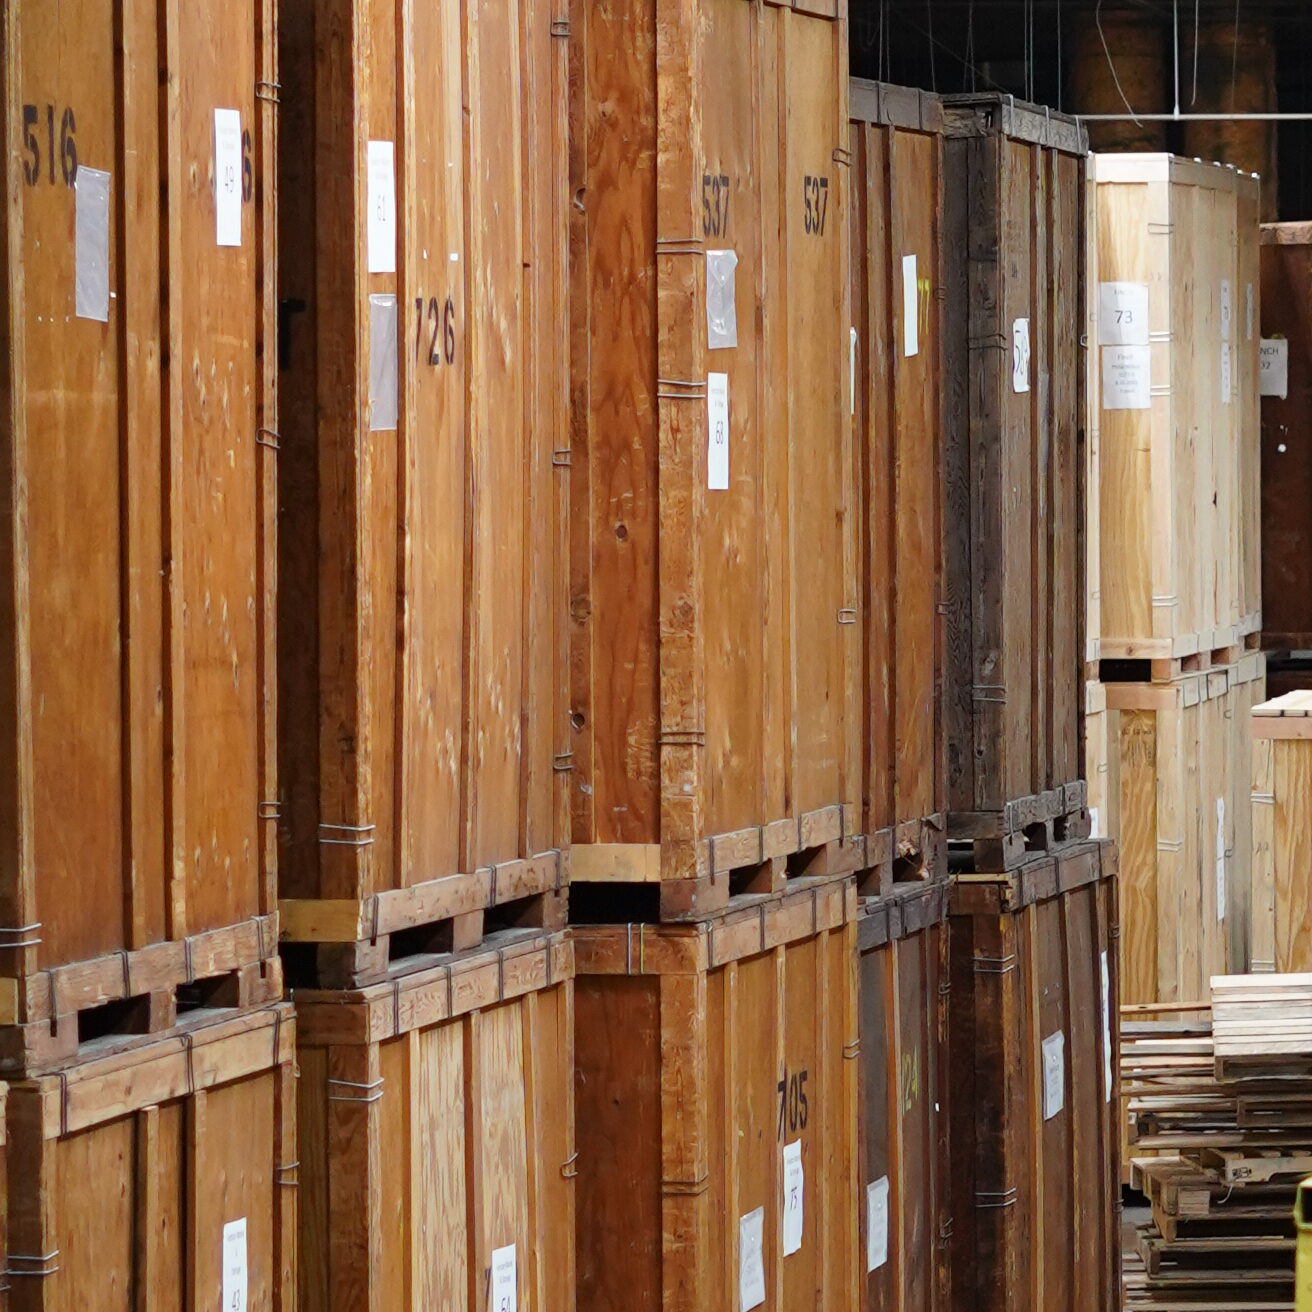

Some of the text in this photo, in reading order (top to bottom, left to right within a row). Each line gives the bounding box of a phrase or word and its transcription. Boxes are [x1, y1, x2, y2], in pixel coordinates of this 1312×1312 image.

[22, 104, 78, 187] 516
[703, 174, 729, 239] 537
[804, 175, 828, 237] 537
[416, 297, 455, 365] 726
[1115, 310, 1133, 324] 73
[778, 1069, 808, 1142] 705
